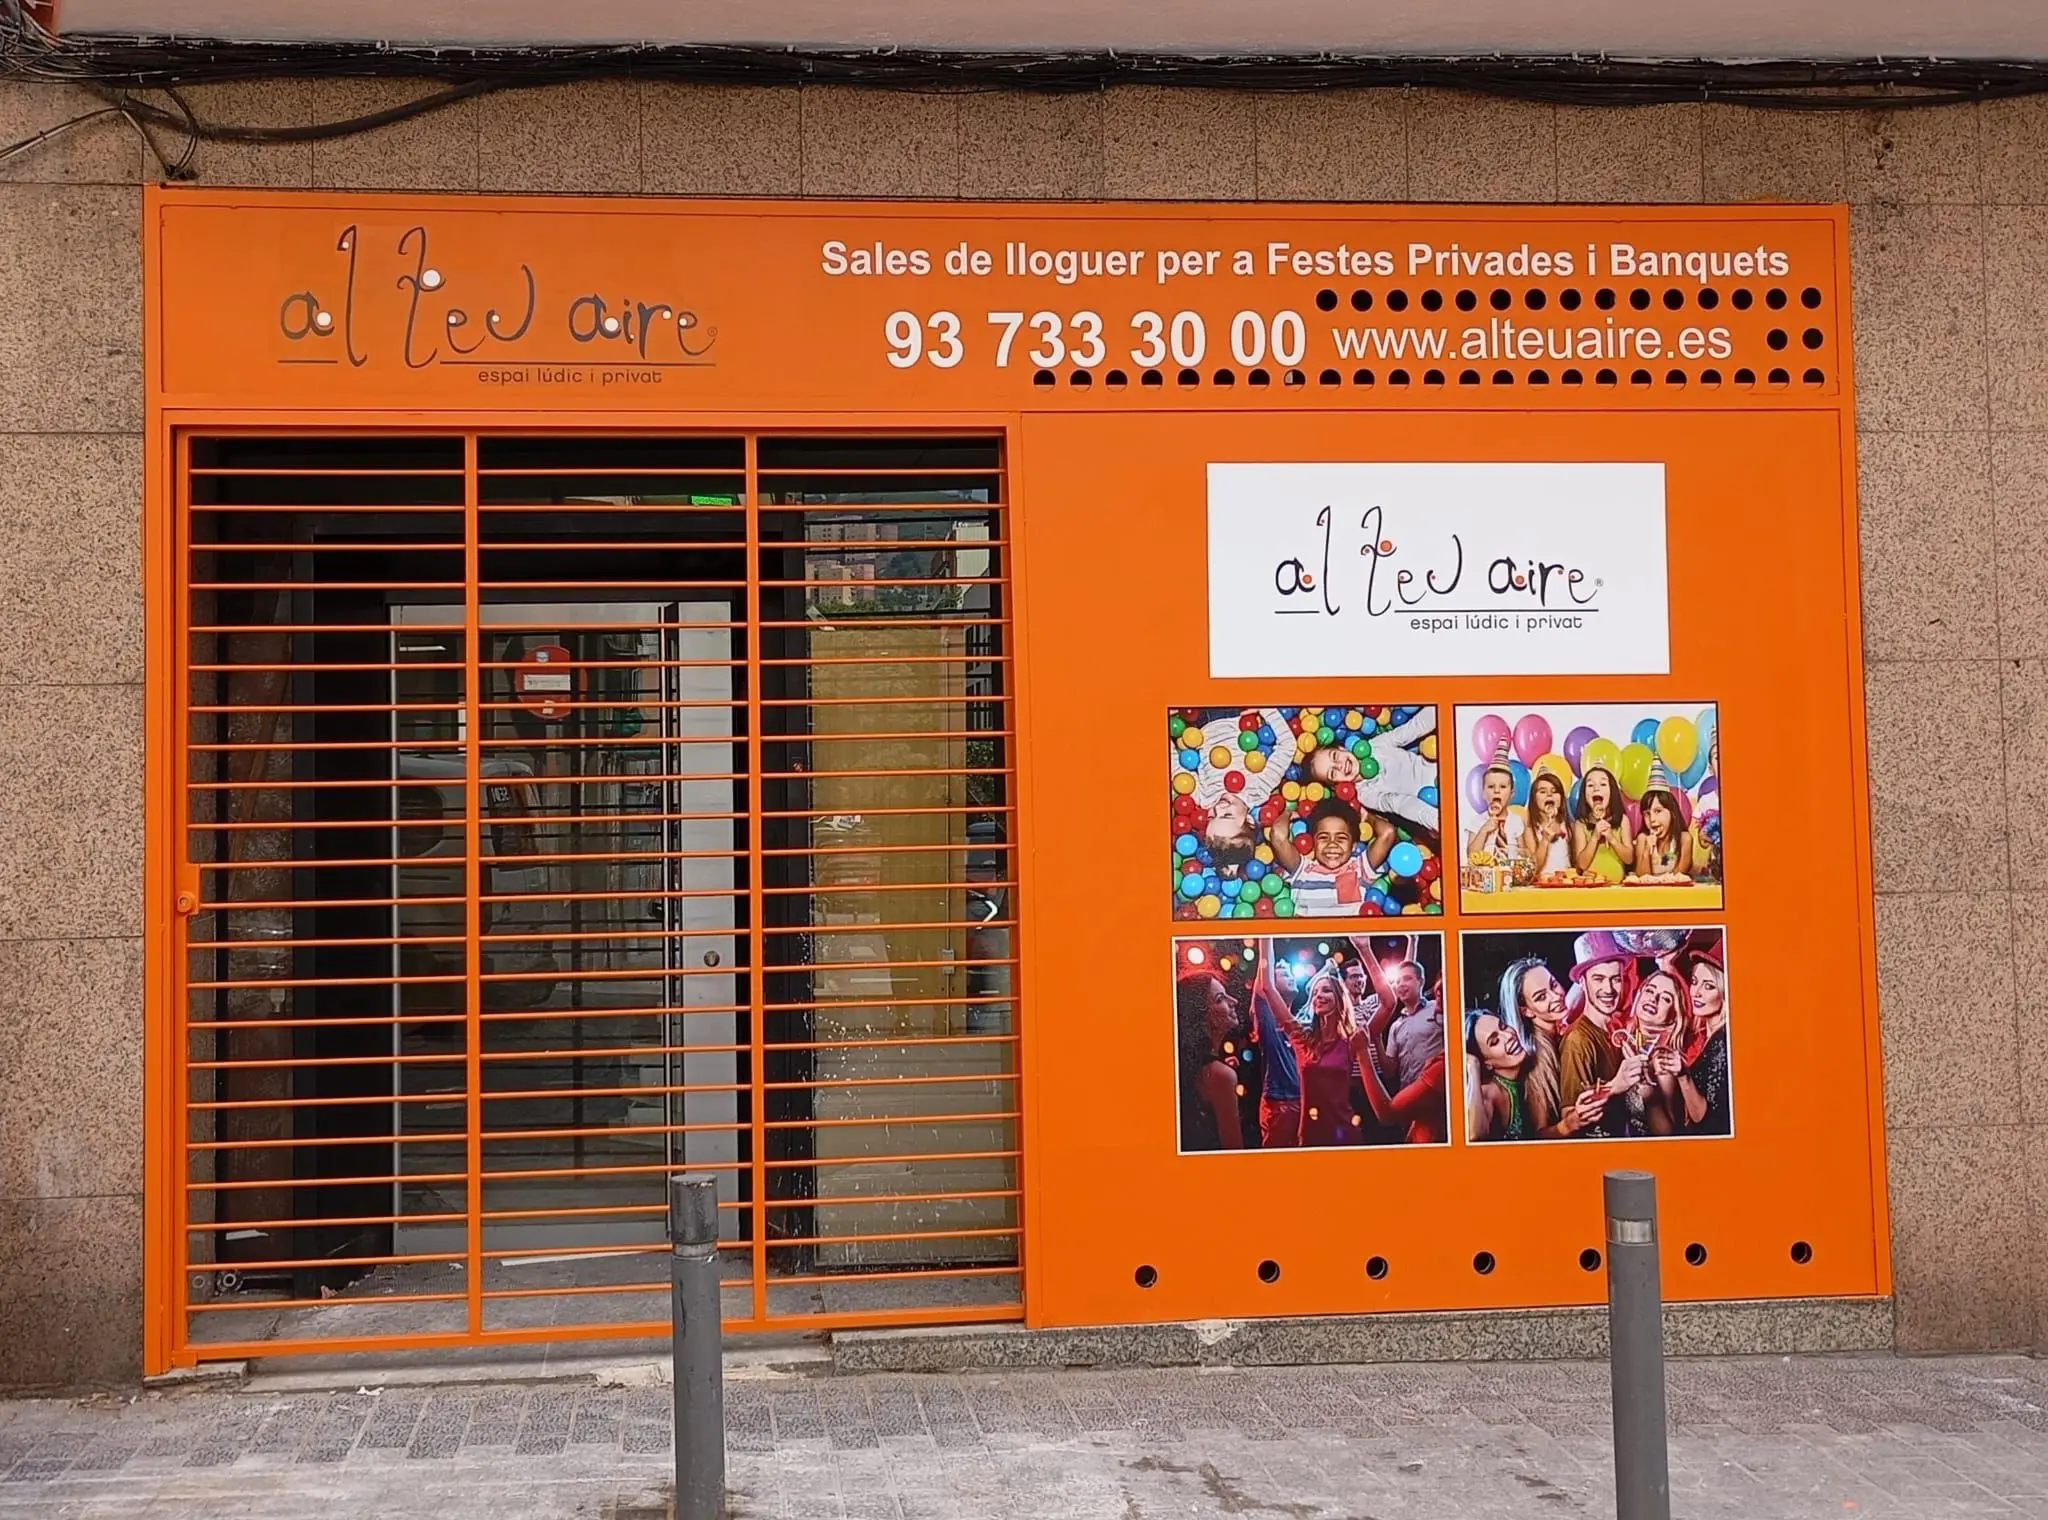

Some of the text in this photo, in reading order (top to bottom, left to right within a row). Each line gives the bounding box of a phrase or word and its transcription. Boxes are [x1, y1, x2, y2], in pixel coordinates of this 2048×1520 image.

[821, 240, 1790, 285] Sales de lloguer per a Festes Privades i Banquets
[280, 225, 367, 367] al
[885, 310, 1307, 368] 93 733 30 00
[1331, 317, 1733, 361] www.alteuaire.es
[478, 368, 530, 384] espai
[536, 367, 583, 383] lúdic
[601, 368, 662, 384] privat
[1275, 505, 1341, 617] al
[1410, 614, 1583, 632] espai lúdic i privat
